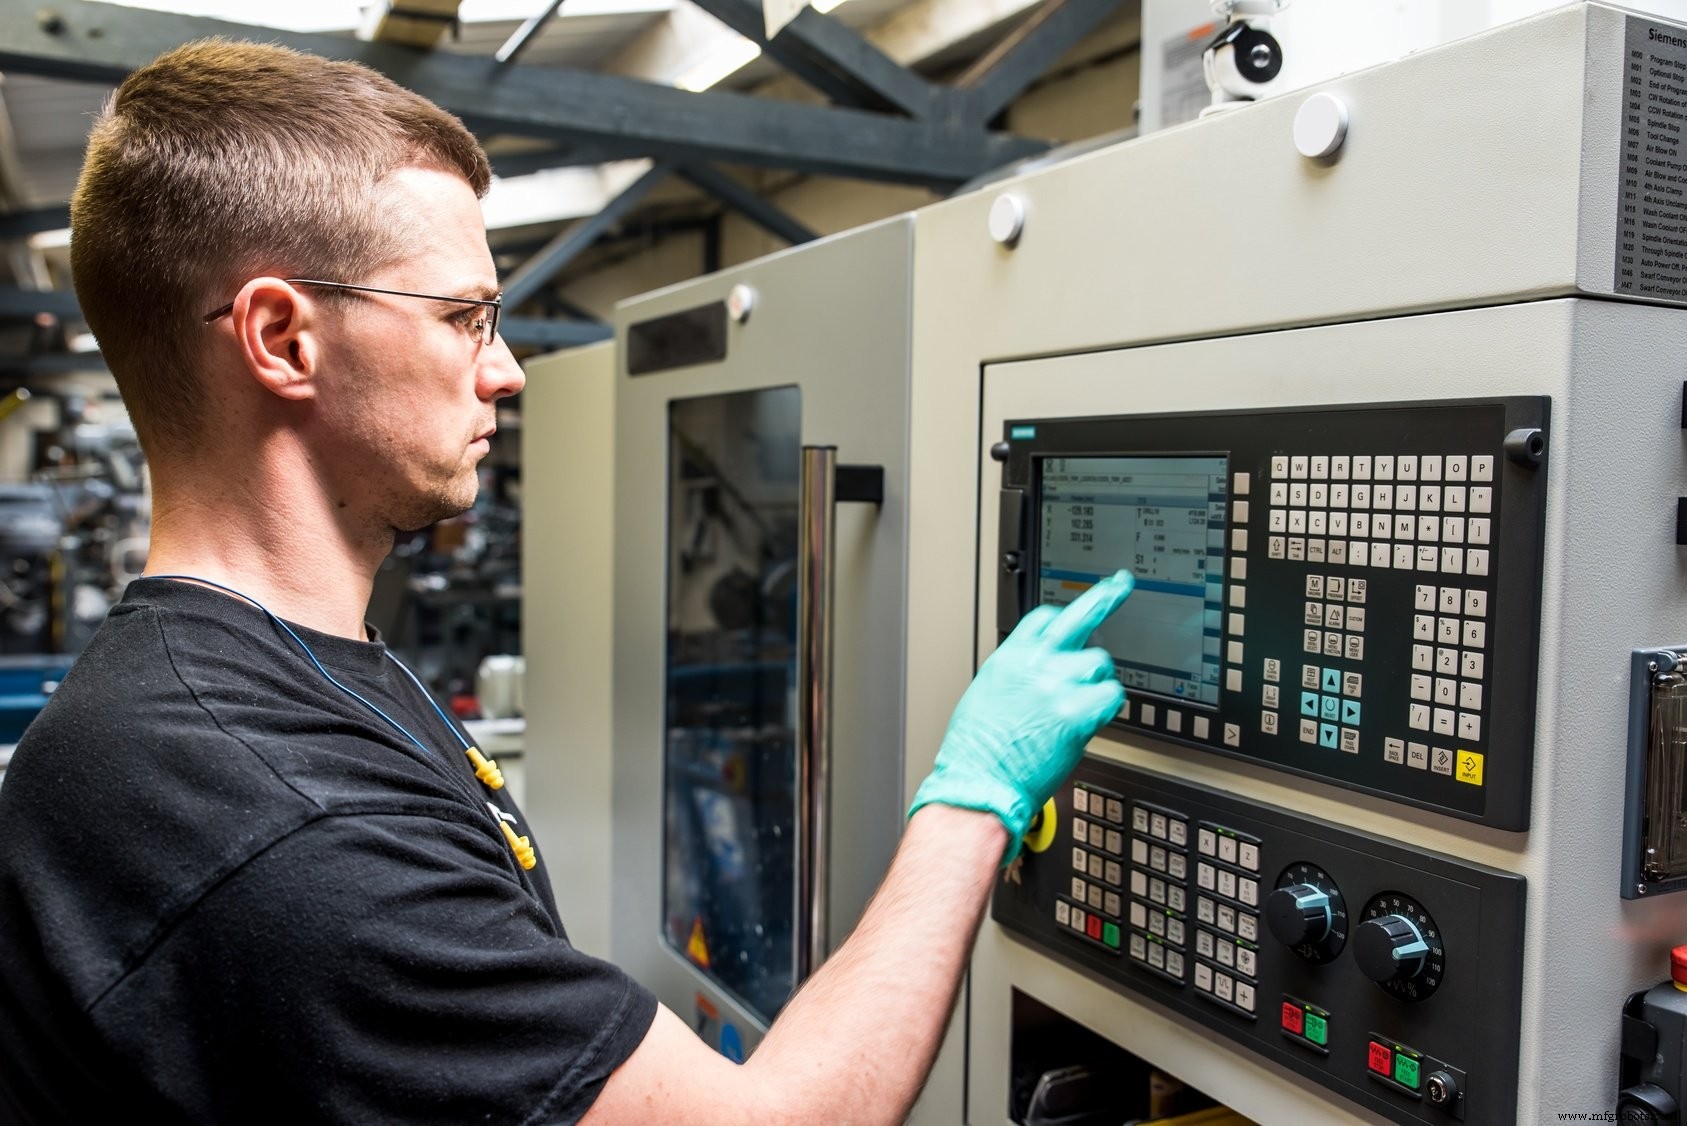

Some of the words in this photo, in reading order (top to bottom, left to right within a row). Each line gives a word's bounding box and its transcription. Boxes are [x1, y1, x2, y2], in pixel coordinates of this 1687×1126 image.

[1648, 28, 1686, 48] Siemens
[1650, 54, 1673, 66] Program
[1674, 60, 1686, 70] Stop
[1631, 63, 1642, 72] M01
[1650, 68, 1672, 78] Optional
[1672, 73, 1686, 83] Stop
[1630, 76, 1642, 85] M02
[1649, 80, 1660, 89] End
[1648, 93, 1658, 101] CW
[1659, 96, 1680, 106] Rotation
[1630, 101, 1640, 110] M04
[1648, 106, 1662, 114] CCW
[1662, 109, 1684, 120] Rotation
[1648, 118, 1667, 129] Spindle
[1668, 123, 1680, 134] Stop
[1646, 131, 1658, 140] Tool
[1660, 134, 1680, 146] Change
[1628, 140, 1638, 149] M07
[1655, 146, 1668, 154] Blow
[1668, 148, 1678, 156] ON
[1646, 157, 1666, 167] Coolant
[1666, 161, 1682, 172] Pump
[1654, 171, 1666, 180] Blow
[1644, 182, 1653, 190] 4th
[1654, 184, 1665, 192] Axis
[1666, 186, 1683, 197] Clamp
[1625, 192, 1636, 200] M11
[1653, 197, 1664, 205] Axis
[1643, 207, 1658, 216] Wash
[1658, 210, 1678, 220] Coolant
[1642, 220, 1658, 229] Wash
[1658, 223, 1678, 232] Coolant
[1642, 233, 1662, 243] Spindle
[1642, 246, 1664, 257] Through
[1664, 249, 1684, 259] Spindle
[1641, 259, 1654, 267] Auto
[1654, 260, 1670, 269] Power
[1640, 272, 1656, 280] Swarf
[1656, 273, 1681, 284] Conveyor
[1640, 284, 1655, 292] Swarf
[1656, 286, 1680, 296] Conveyor
[1303, 727, 1315, 735] END
[1412, 751, 1423, 760] DEL
[1336, 932, 1344, 940] 120
[1428, 930, 1435, 938] 90
[1432, 947, 1442, 956] 100
[1427, 977, 1436, 986] 120
